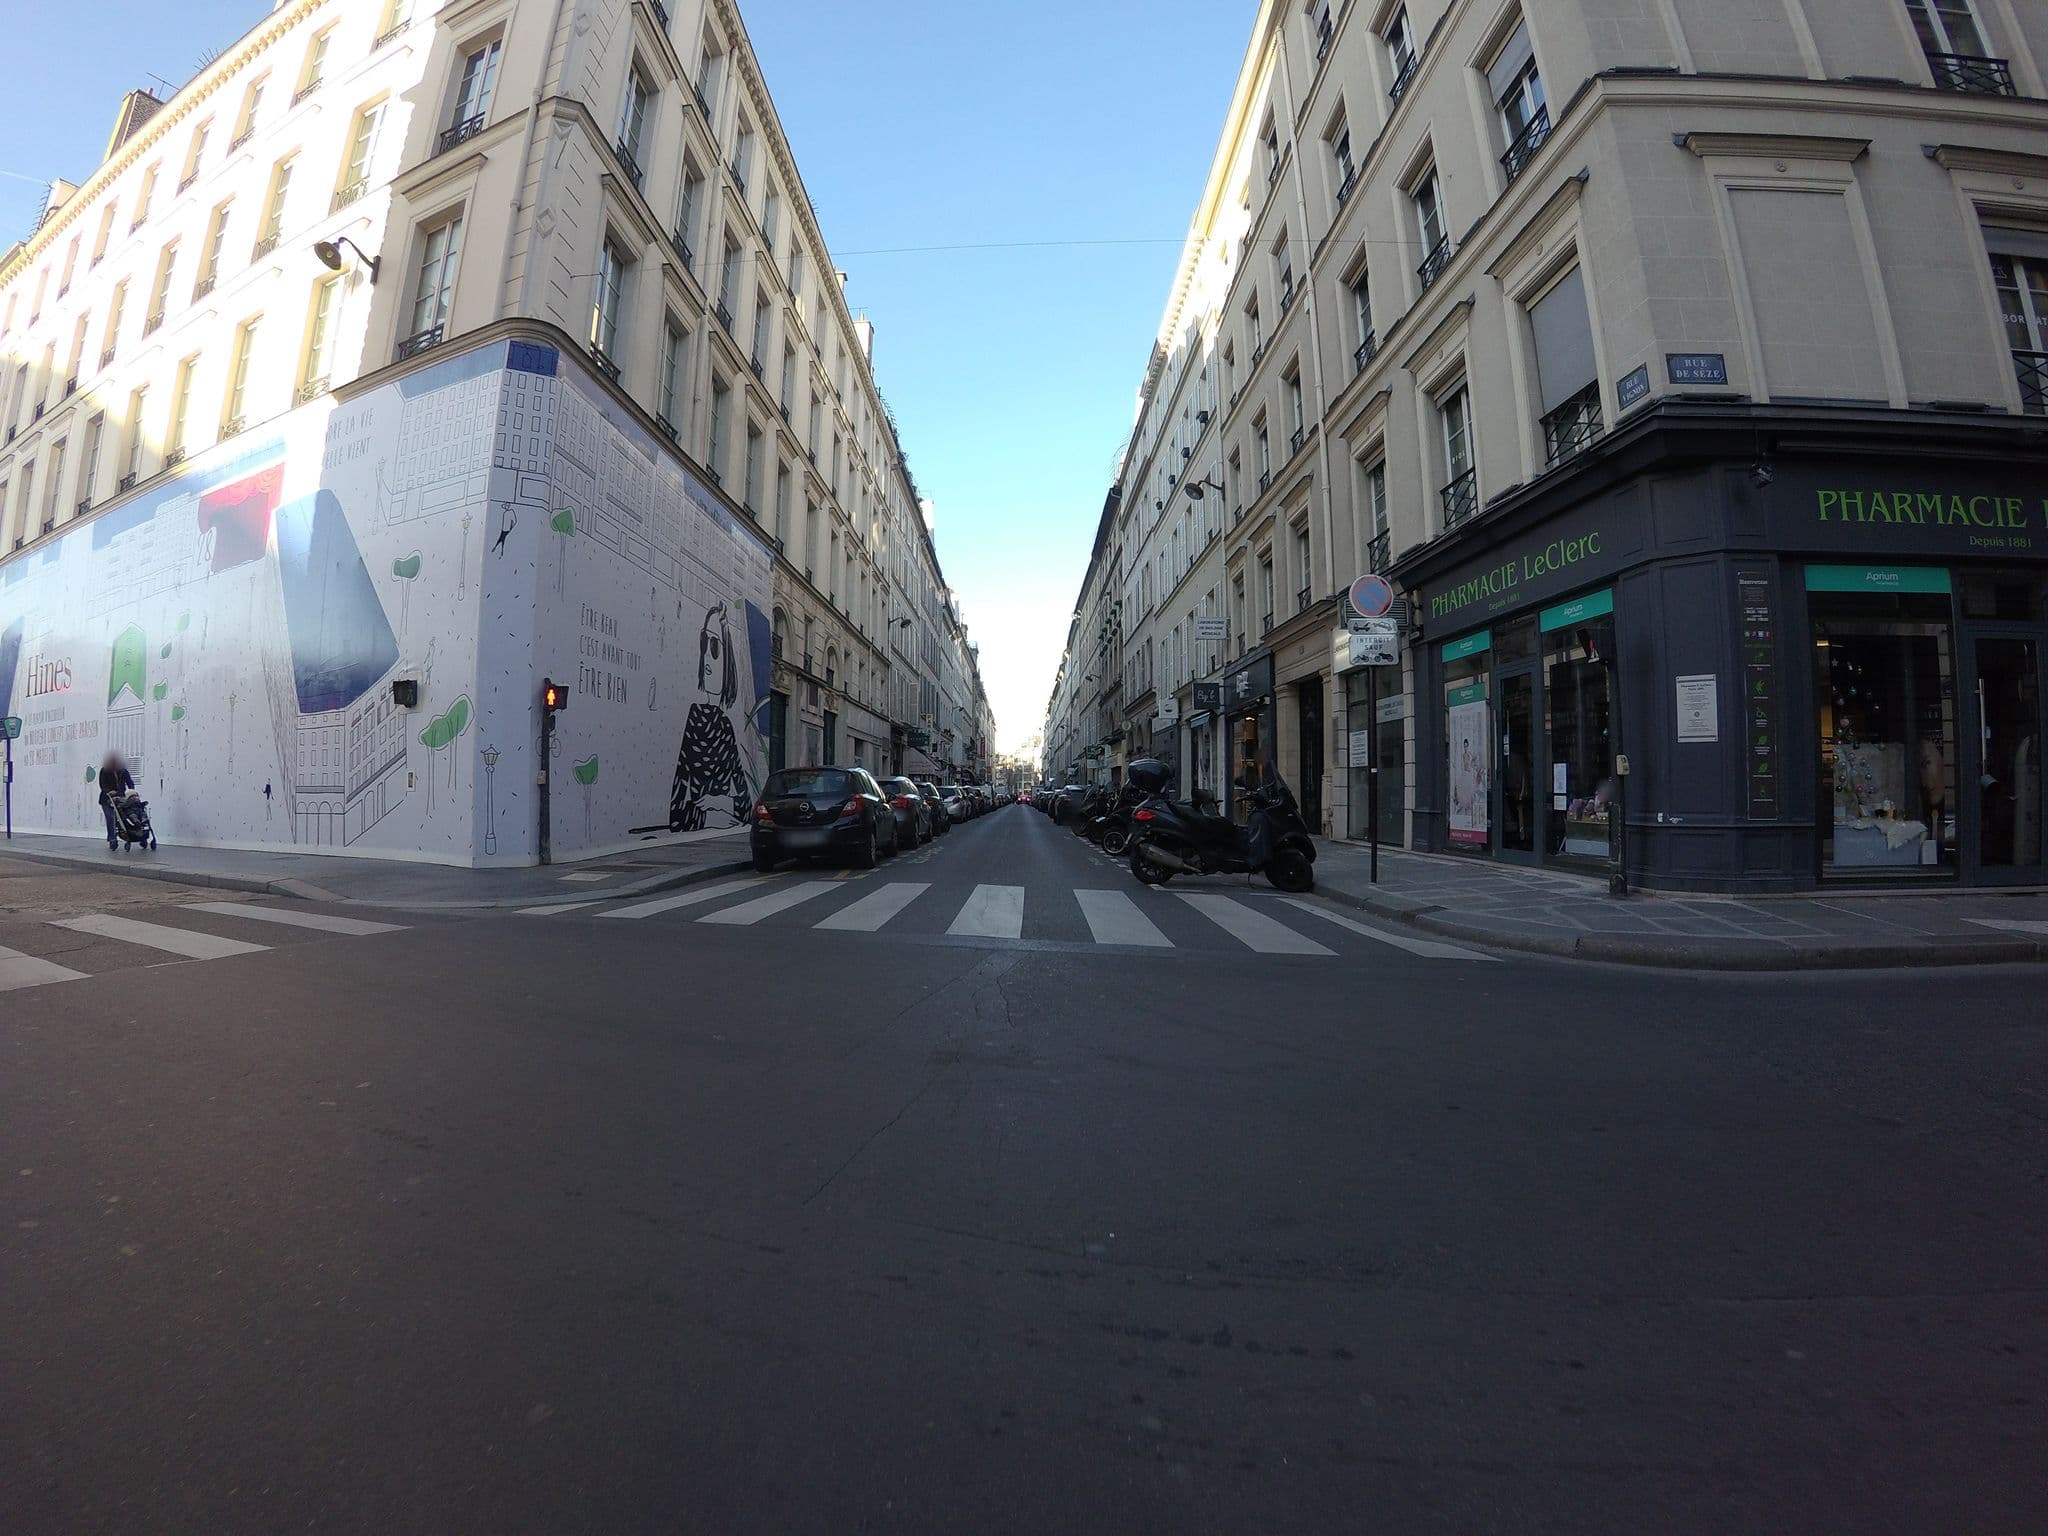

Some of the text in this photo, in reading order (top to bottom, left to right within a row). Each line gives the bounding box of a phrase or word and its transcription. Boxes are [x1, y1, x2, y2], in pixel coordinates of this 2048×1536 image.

[1676, 369, 1690, 378] DE
[1684, 359, 1708, 368] RUE
[1622, 384, 1645, 402] VIGNON
[1626, 375, 1639, 390] RUE
[345, 416, 355, 435] LA
[361, 408, 374, 428] VIE
[347, 436, 372, 461] VIENT
[1816, 490, 2027, 528] PHARMACIE
[1969, 535, 2032, 548] Depuis 1881
[1432, 532, 1601, 618] PHARMACIE LeClerc
[1866, 571, 1899, 583] Aprium
[581, 603, 598, 631] ÊTRE
[579, 635, 641, 671] C'EST AVANT TOUT
[26, 653, 72, 698] Hines
[578, 661, 628, 704] ÊTRE BIEN
